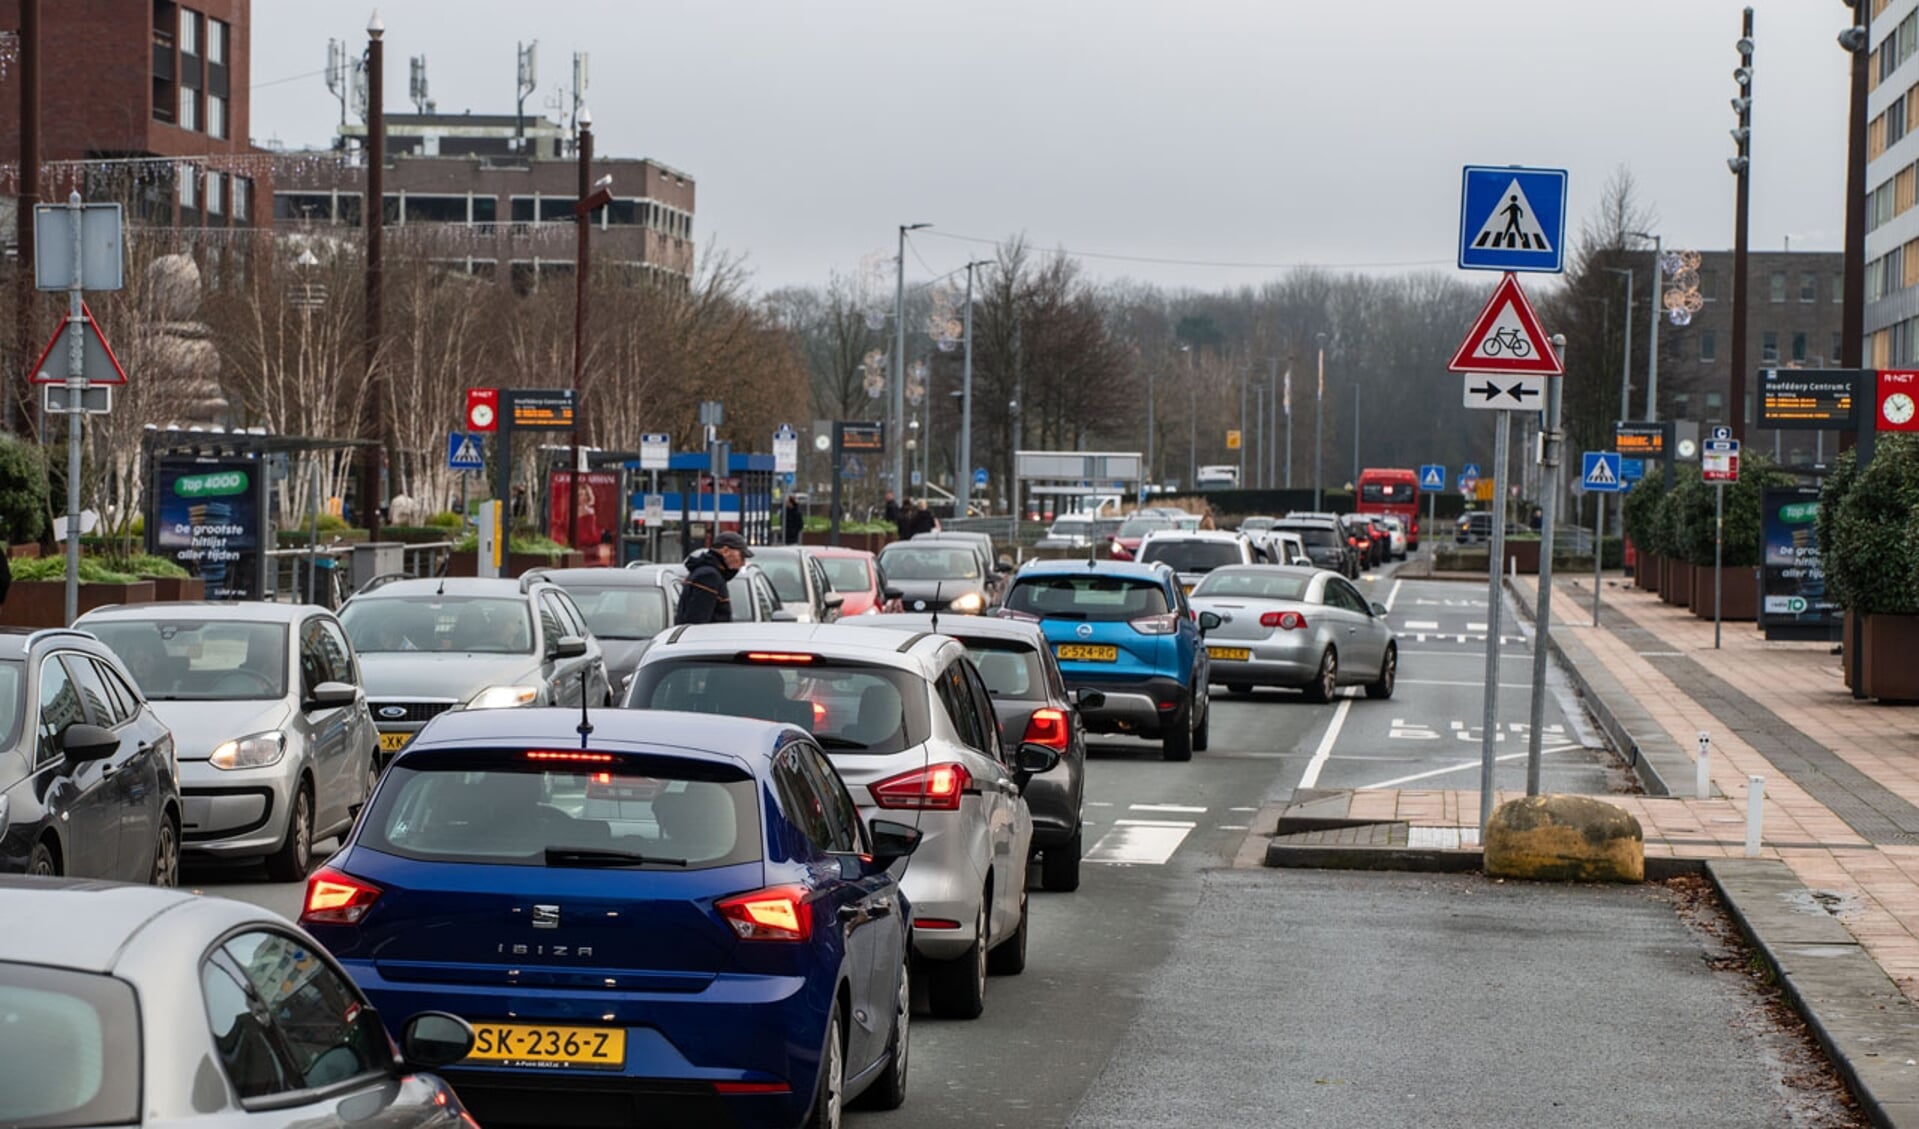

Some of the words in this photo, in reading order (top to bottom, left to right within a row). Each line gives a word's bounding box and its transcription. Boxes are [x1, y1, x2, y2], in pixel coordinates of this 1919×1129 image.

[1765, 383, 1807, 391] Hoofddorp
[1717, 428, 1728, 439] C
[182, 478, 202, 492] Top
[205, 475, 240, 488] 4000
[176, 524, 190, 533] De
[193, 525, 244, 536] grootste
[191, 536, 227, 547] hitlijst
[1780, 546, 1793, 555] De
[177, 551, 205, 561] aller
[207, 551, 240, 562] tijden
[1060, 646, 1113, 659] G-524-RG
[498, 944, 593, 956] IBIZA
[476, 1028, 610, 1058] SK-236-Z
